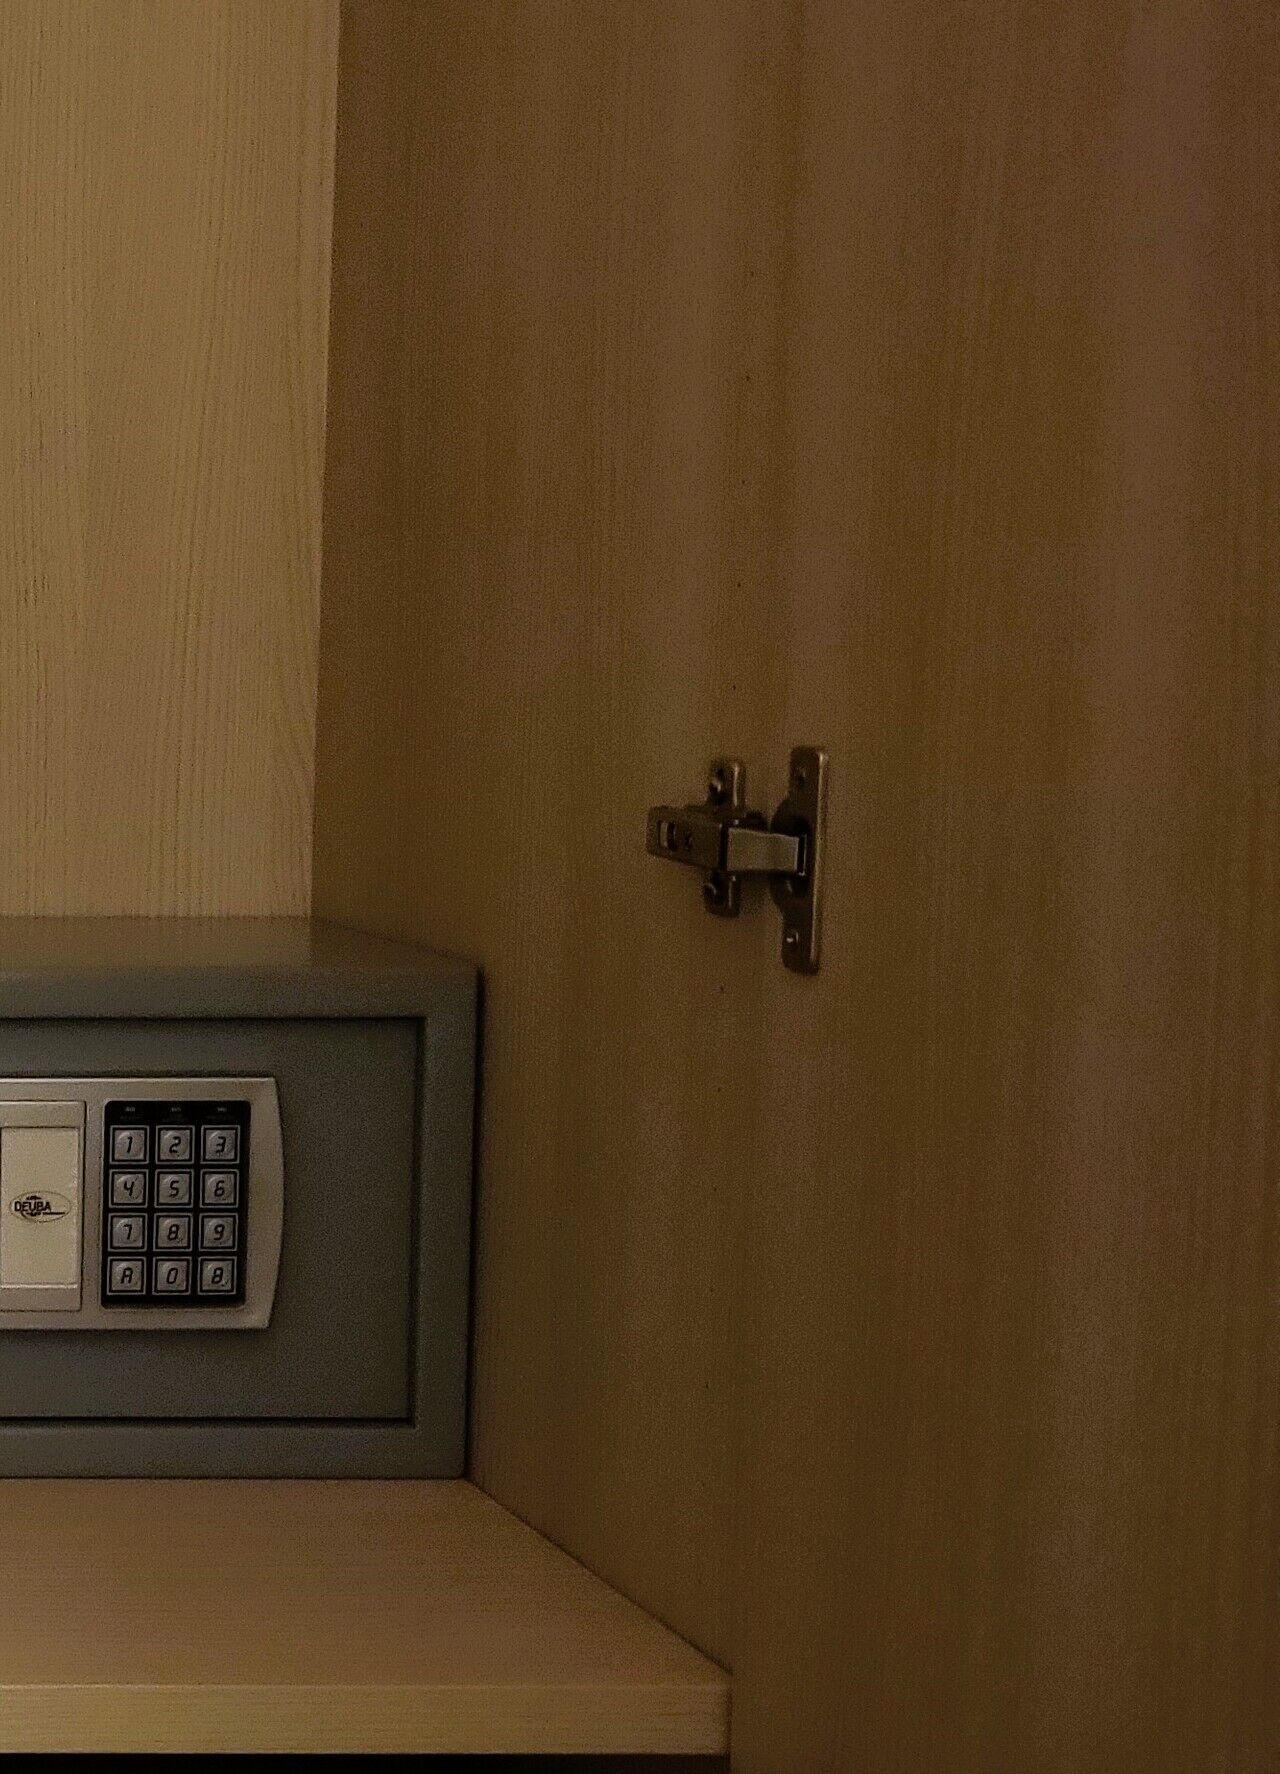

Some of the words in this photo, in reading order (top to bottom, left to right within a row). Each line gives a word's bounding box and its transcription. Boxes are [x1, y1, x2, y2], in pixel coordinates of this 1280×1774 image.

[125, 1136, 134, 1153] 1
[168, 1135, 182, 1153] 2
[215, 1136, 227, 1153] 3
[123, 1180, 135, 1197] 4
[168, 1180, 180, 1198] 5
[213, 1180, 226, 1197] 6
[123, 1224, 133, 1241] 7
[167, 1224, 180, 1241] 8
[213, 1224, 225, 1241] 9
[120, 1267, 134, 1285] A
